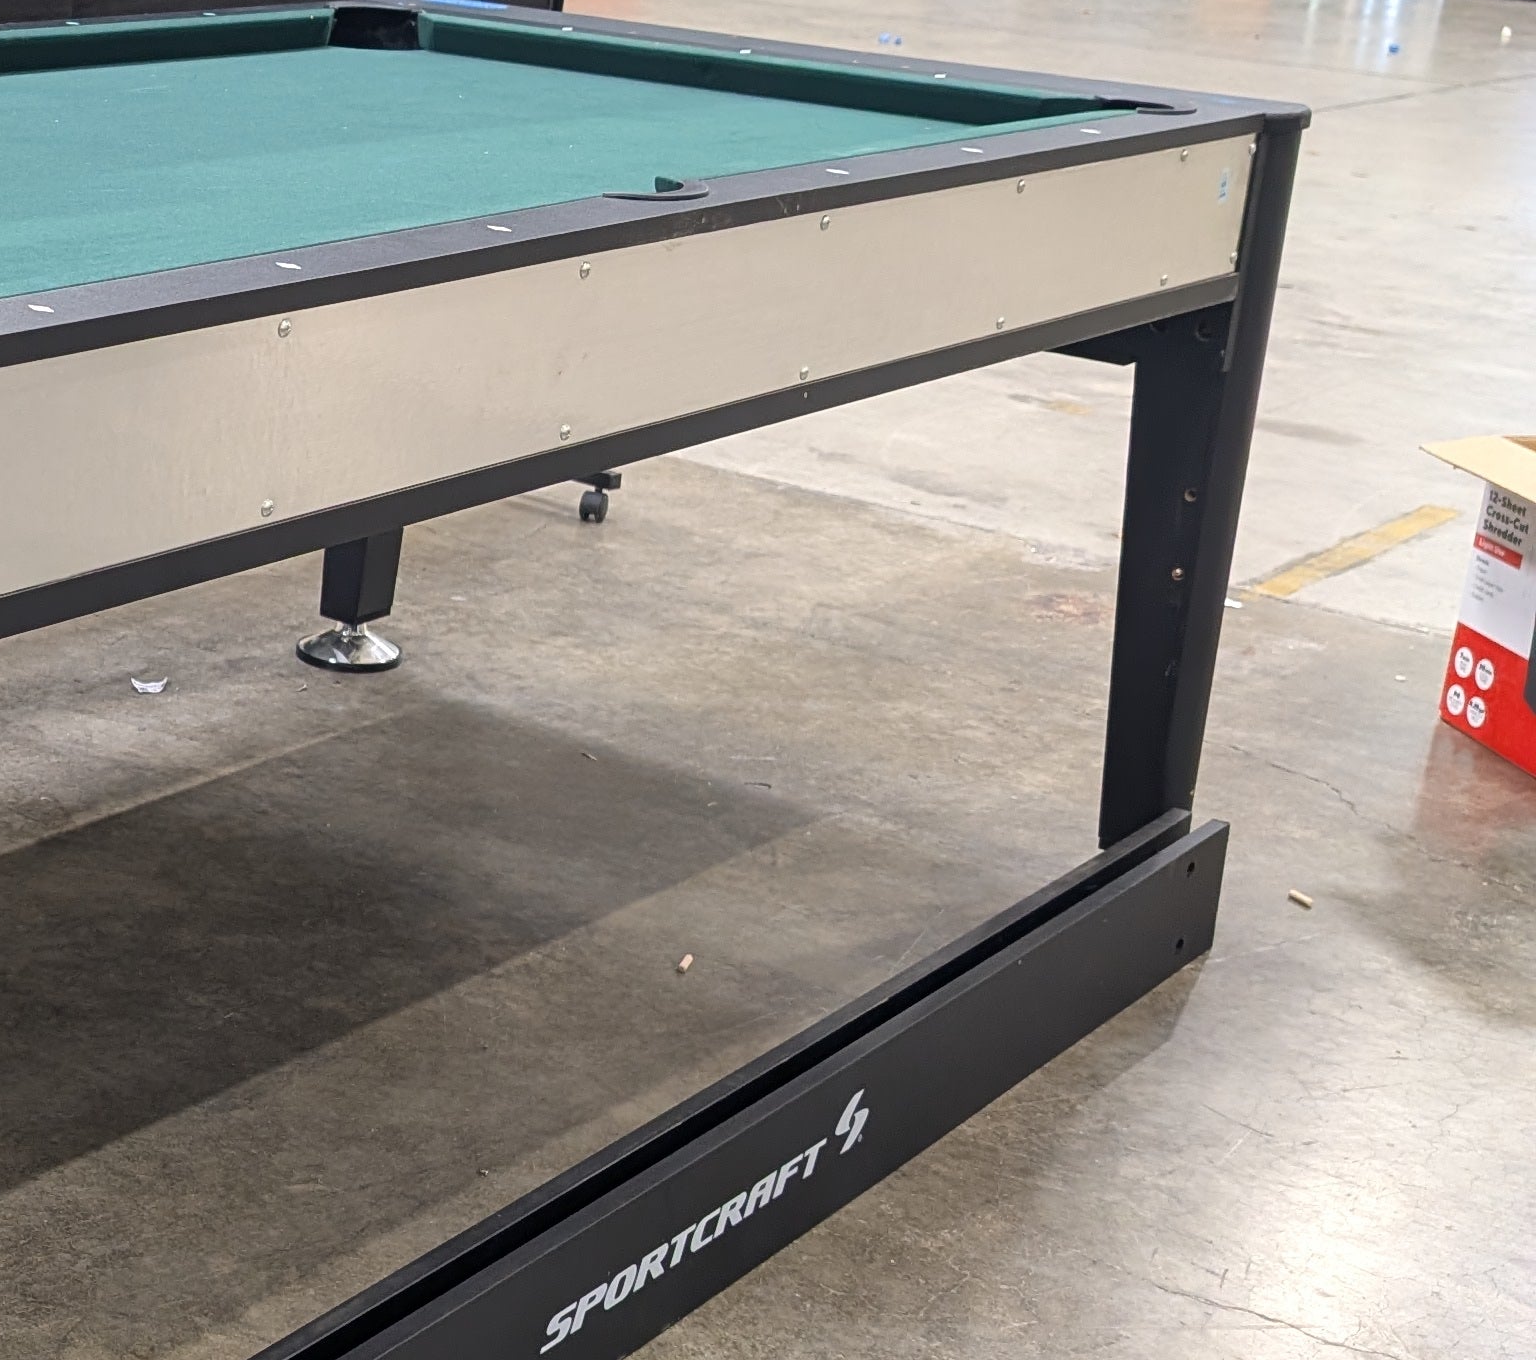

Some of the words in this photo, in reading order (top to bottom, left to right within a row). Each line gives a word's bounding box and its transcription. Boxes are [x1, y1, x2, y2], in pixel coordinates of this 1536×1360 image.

[1489, 489, 1527, 517] 12-Sheet
[1483, 519, 1523, 546] Shredder
[1486, 505, 1529, 535] Cross-Cut
[539, 1138, 828, 1355] SPORTCRAFT
